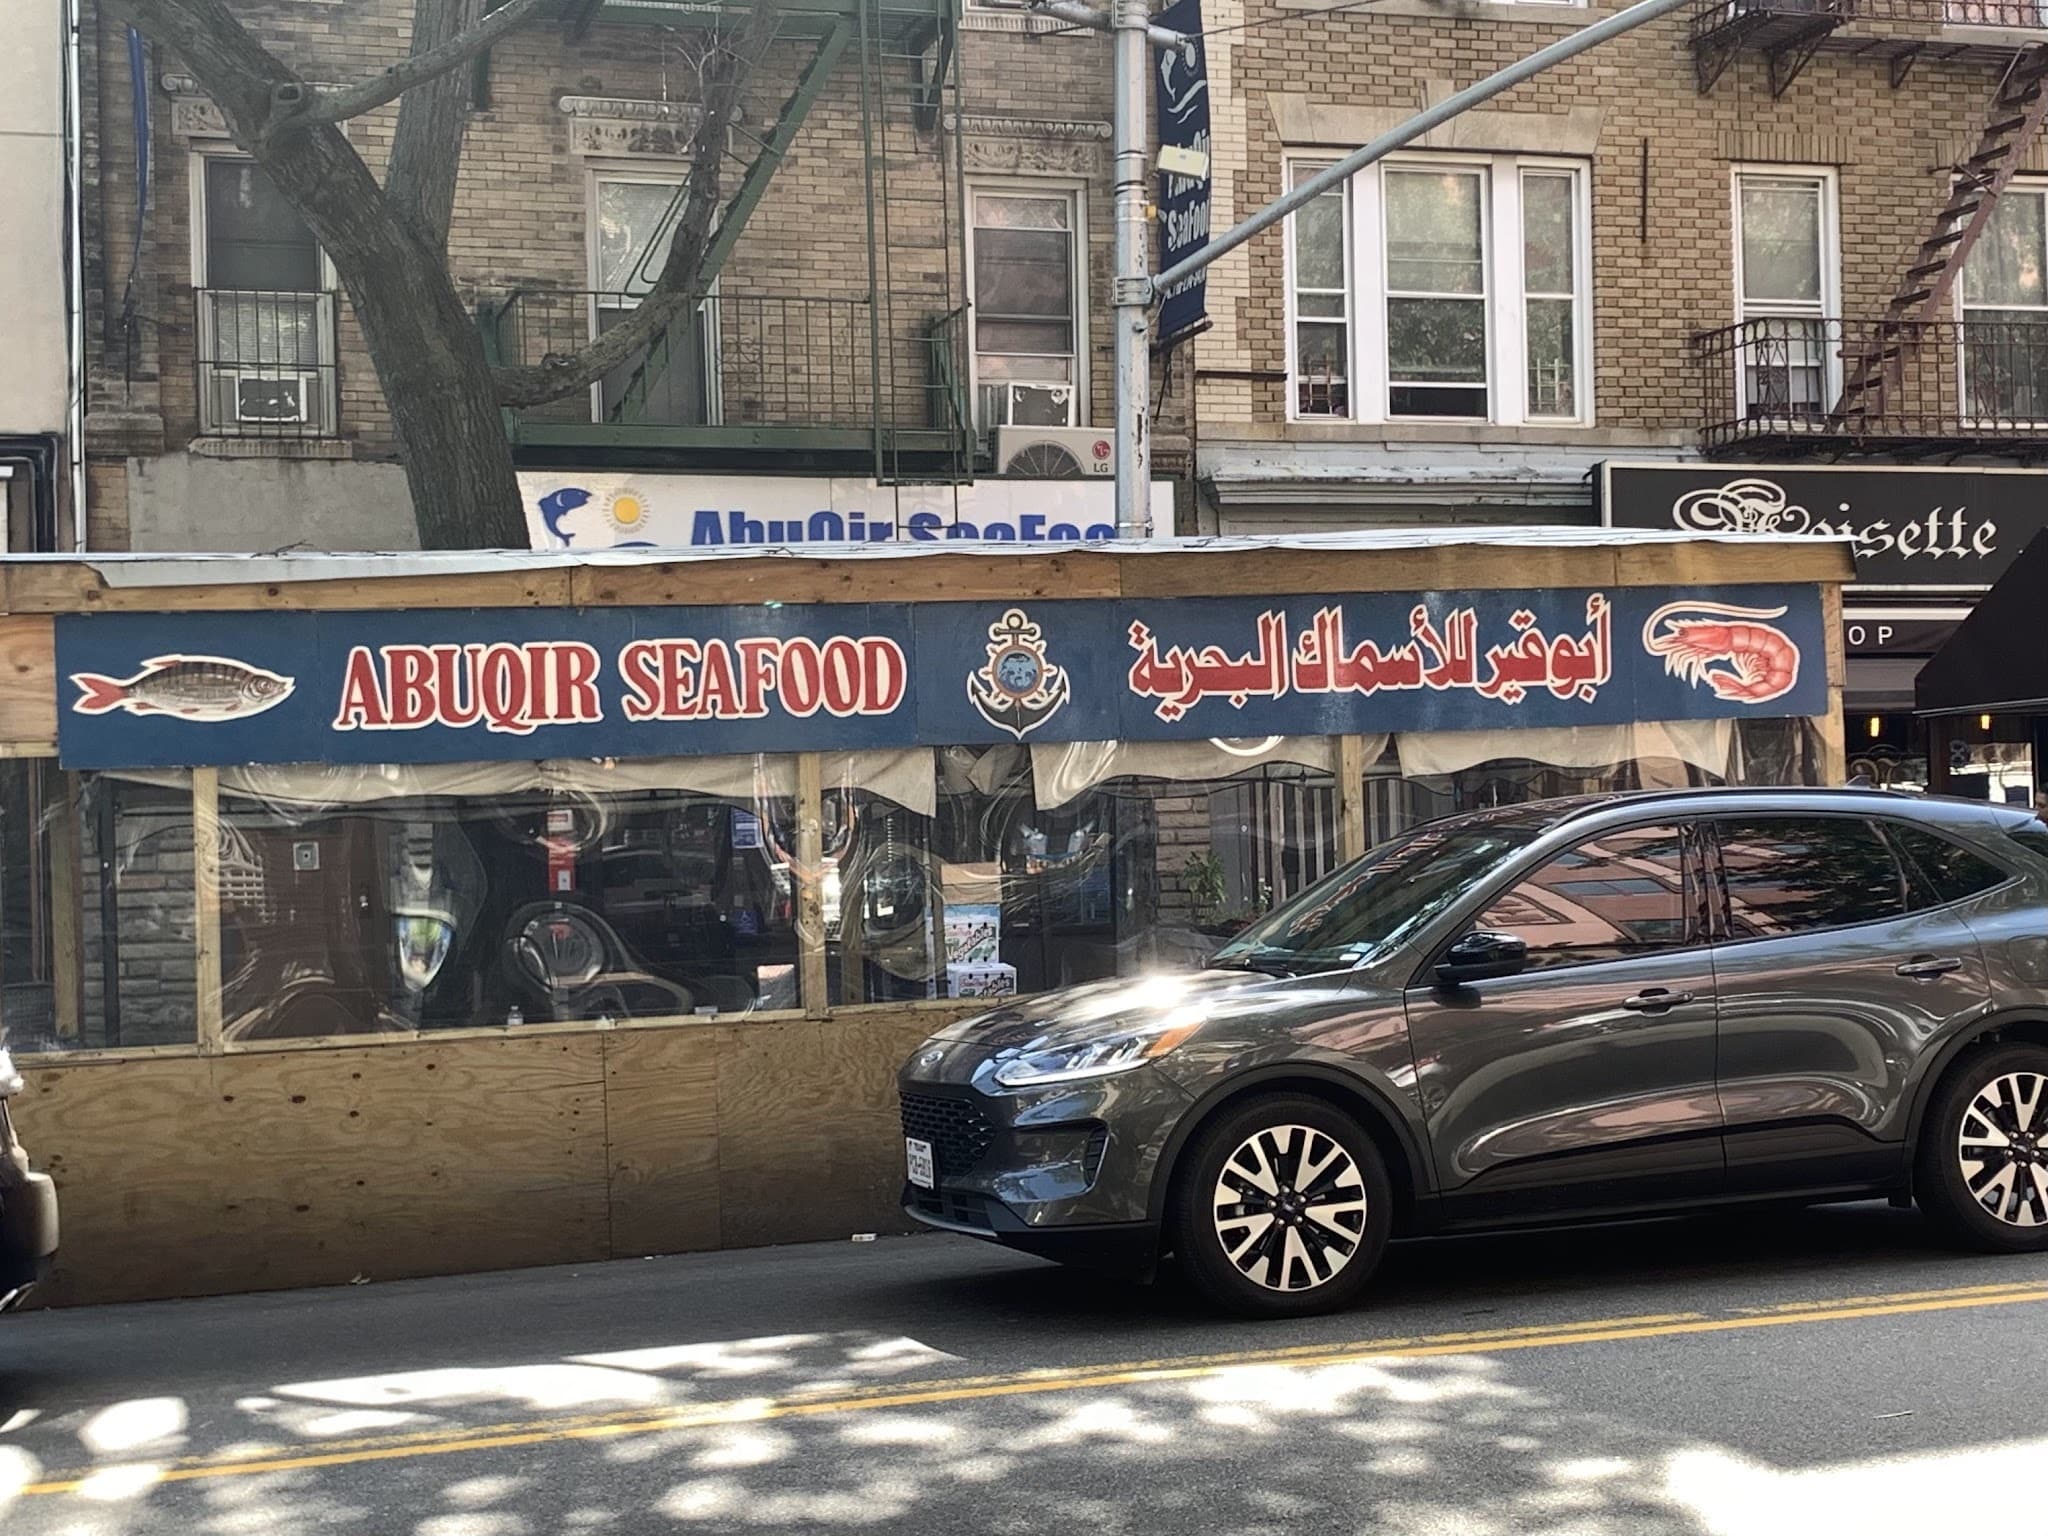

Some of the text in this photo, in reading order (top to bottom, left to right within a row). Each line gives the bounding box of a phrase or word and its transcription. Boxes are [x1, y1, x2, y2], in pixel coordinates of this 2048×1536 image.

[1093, 462, 1109, 473] LG
[332, 636, 907, 735] ABUQIR SEAFOOD
[1128, 609, 1286, 723] البحرية
[1293, 604, 1478, 697] للأسماك
